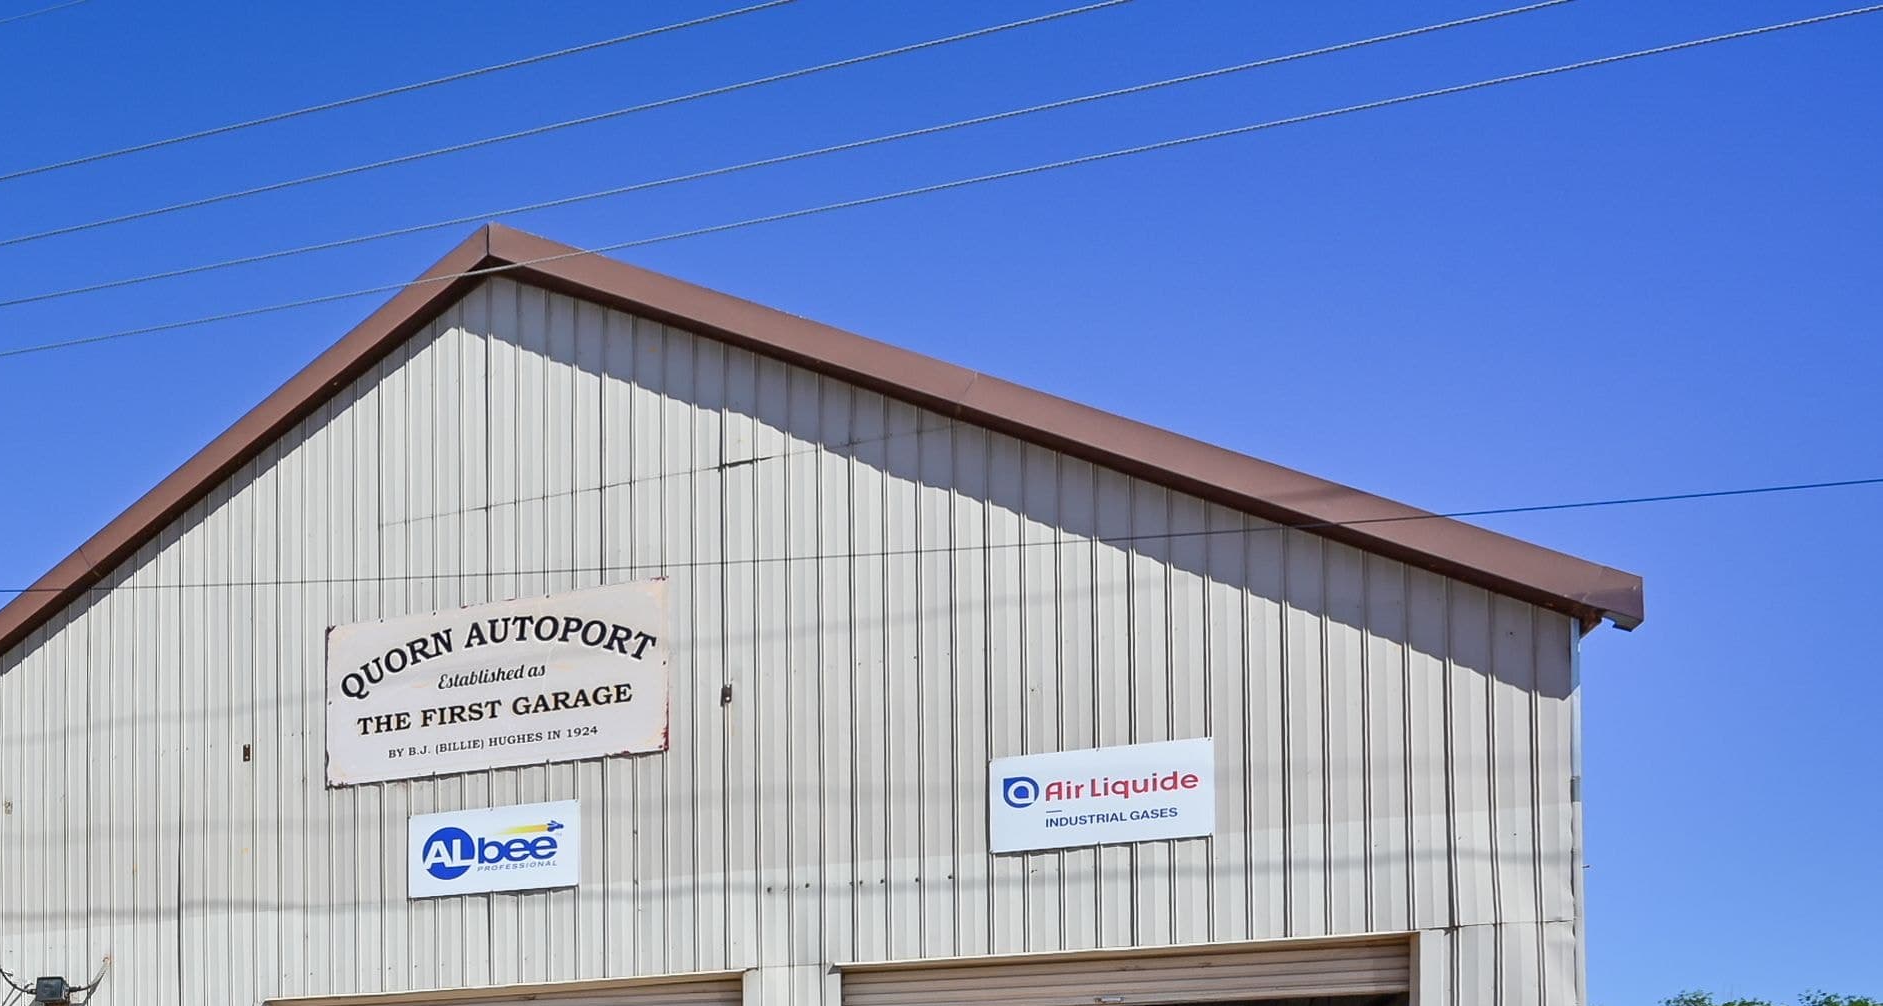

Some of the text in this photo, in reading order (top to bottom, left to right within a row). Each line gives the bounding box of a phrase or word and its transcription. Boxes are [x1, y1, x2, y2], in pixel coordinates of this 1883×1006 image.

[341, 615, 657, 700] QUORN AUTOPORT
[438, 664, 546, 690] Established as
[357, 683, 633, 736] THE FIRST GARAGE
[388, 725, 598, 759] BY B.J. (BILLIE) HUGHES IN 1924
[1045, 771, 1199, 802] Air Liquide
[1045, 807, 1178, 828] INDUSTRIAL GASES
[477, 861, 558, 872] PROFESSIONAL
